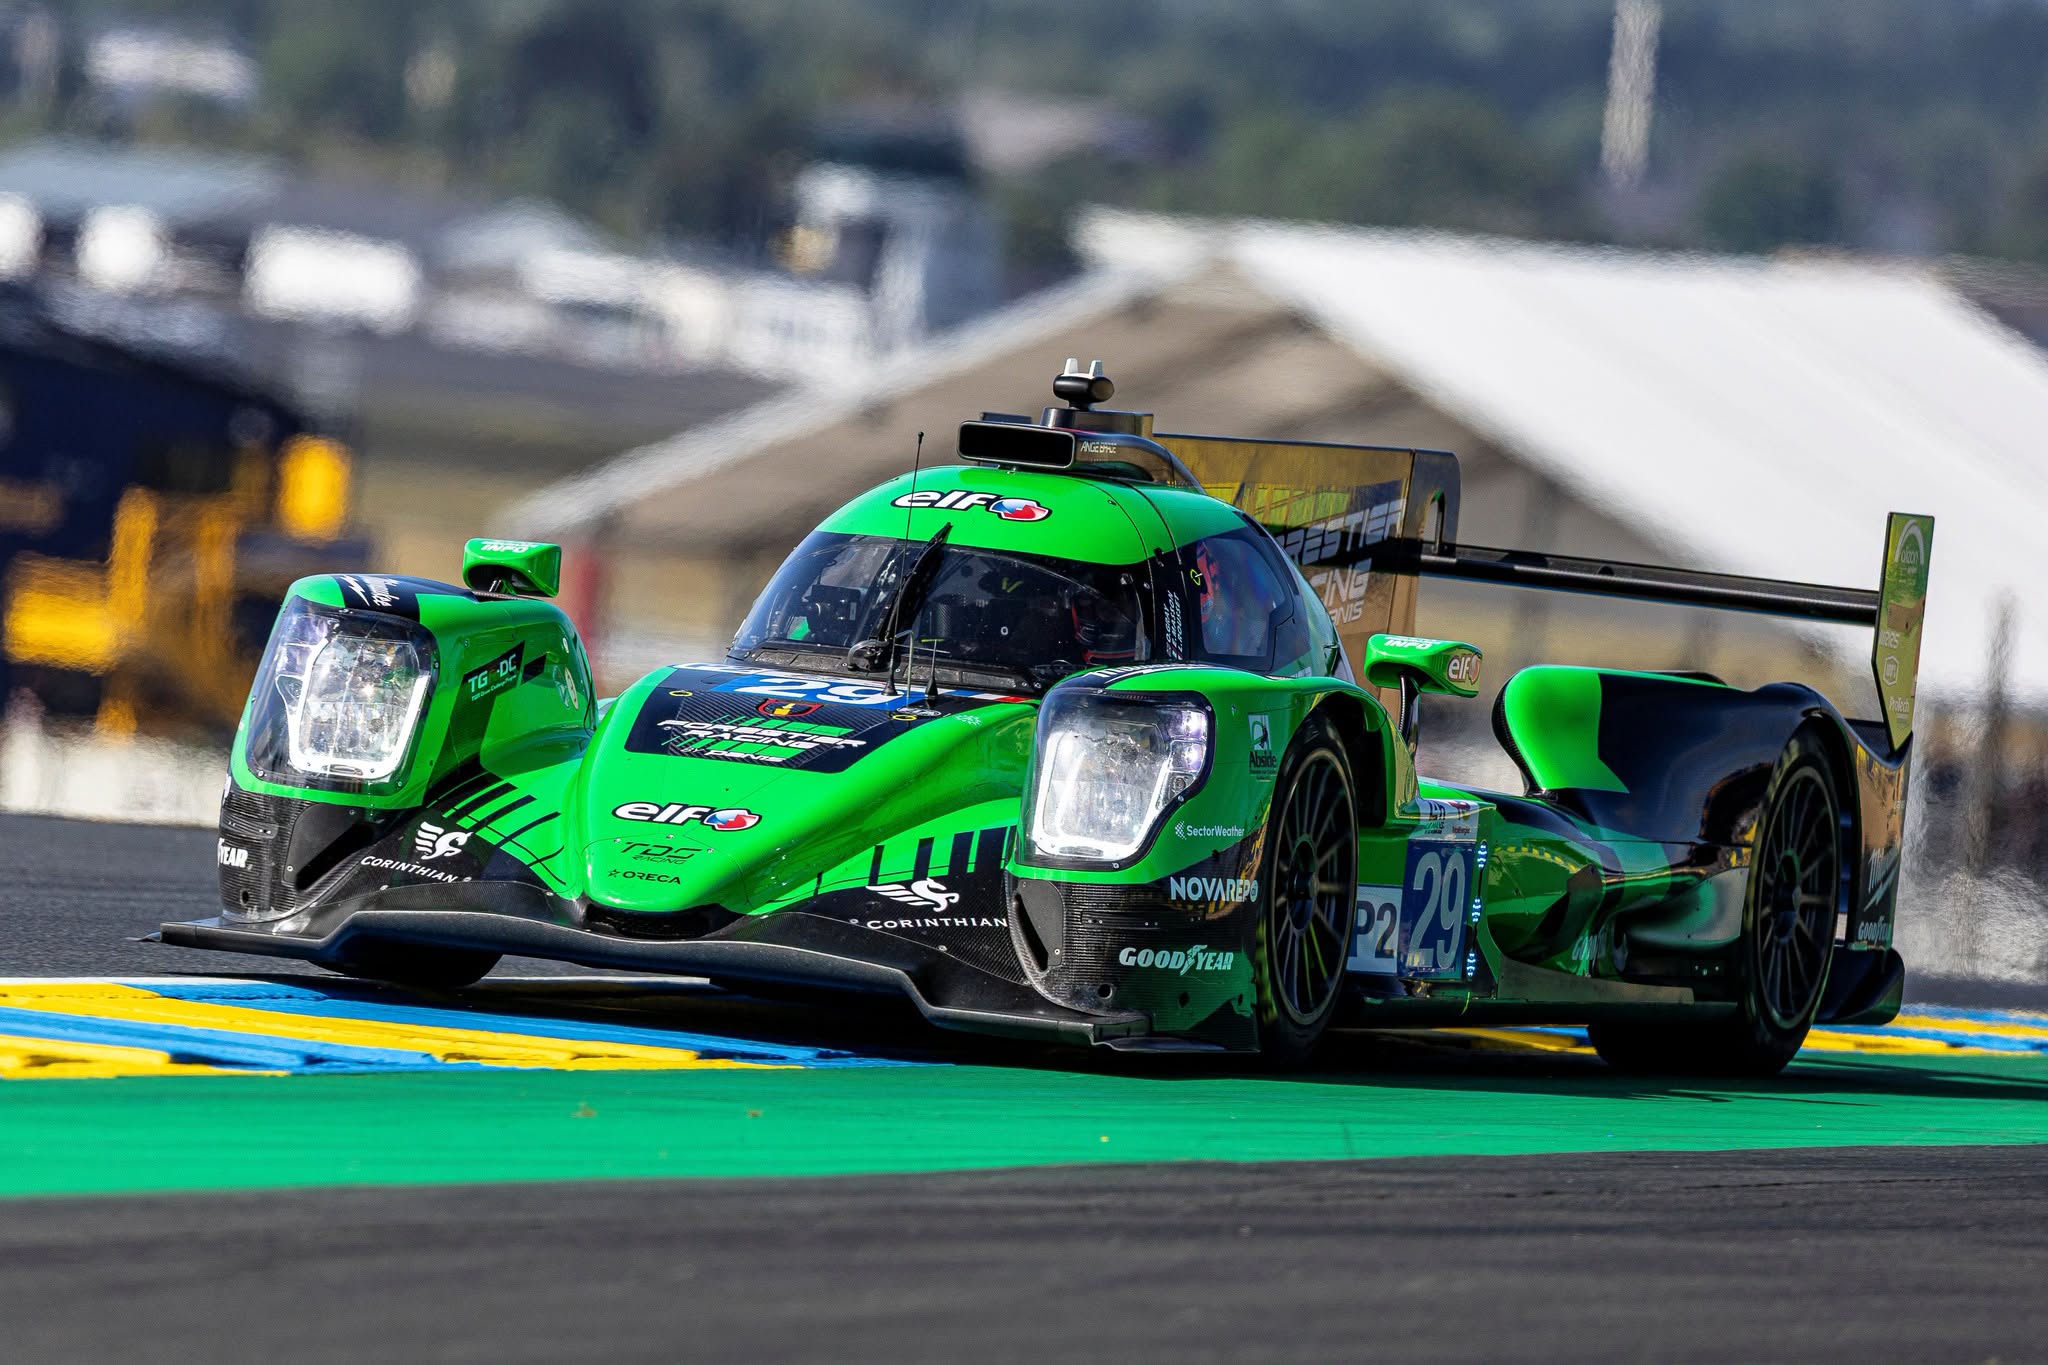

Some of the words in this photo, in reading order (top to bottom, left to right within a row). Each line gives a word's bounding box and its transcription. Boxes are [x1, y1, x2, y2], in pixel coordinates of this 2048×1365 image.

[894, 490, 997, 511] elf
[1276, 498, 1407, 566] RESTIER
[1308, 558, 1372, 607] CING
[1448, 655, 1471, 680] elf
[732, 677, 905, 706] 29
[656, 719, 868, 748] FORESTIER
[681, 729, 820, 750] RACING
[614, 801, 712, 825] elf
[1186, 825, 1245, 838] SectorWeather
[620, 841, 703, 860] TDS
[631, 855, 688, 865] RACING
[360, 856, 459, 883] CORINTHIAN
[623, 871, 681, 885] ORECA
[1405, 851, 1466, 970] 29
[867, 917, 1009, 930] CORINTHIAN
[1118, 945, 1234, 976] GOODYEAR
